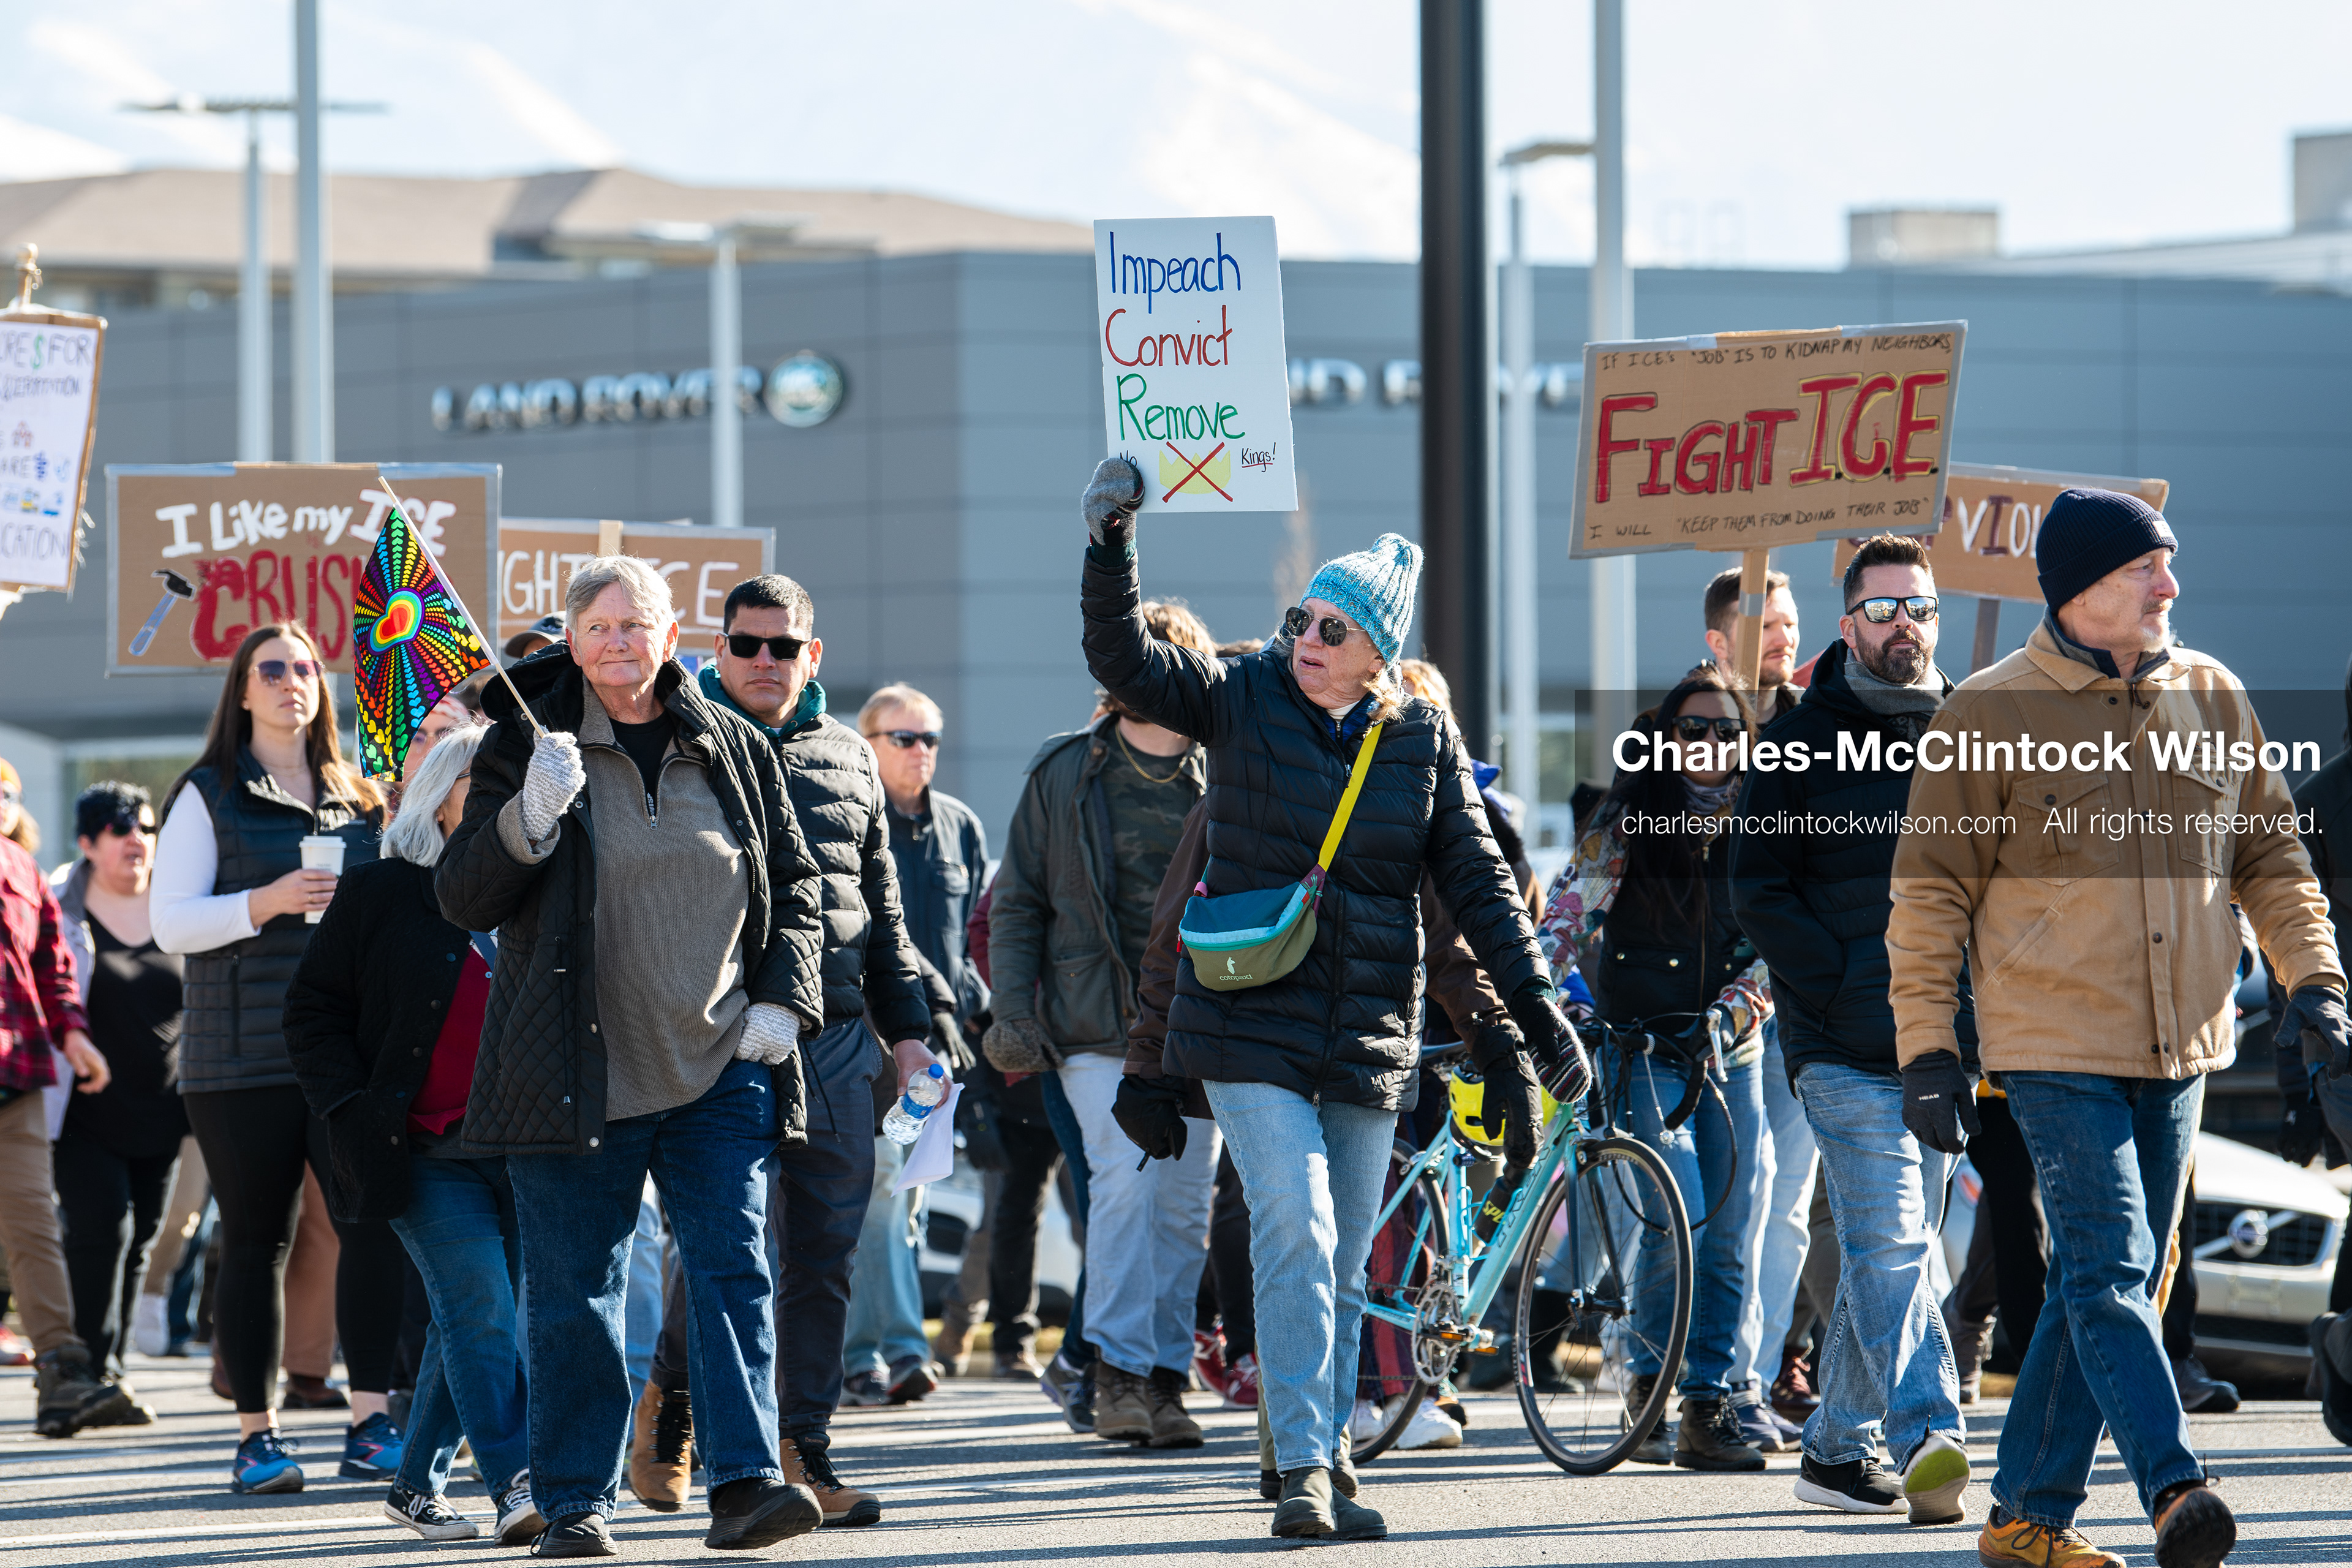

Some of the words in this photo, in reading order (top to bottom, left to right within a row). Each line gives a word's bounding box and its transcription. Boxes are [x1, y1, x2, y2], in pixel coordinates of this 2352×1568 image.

[1110, 231, 1242, 314] Impeach
[1105, 304, 1233, 367] Convict
[1601, 352, 1621, 371] IF
[1691, 347, 1730, 365] "JOB"
[1733, 347, 1755, 364] IS
[1761, 345, 1777, 360] TO
[1785, 337, 1841, 360] KIDNAP
[1841, 337, 1863, 355] MY
[1115, 372, 1246, 440] Remove
[1241, 442, 1276, 473] Kings!
[1595, 392, 1801, 505] FIGHT
[155, 502, 204, 559] I
[292, 505, 354, 547] my
[1589, 524, 1604, 540] I
[1615, 523, 1653, 537] WILL
[1722, 514, 1756, 532] THEM
[1759, 511, 1792, 528] FROM
[1794, 508, 1836, 526] DOING
[1845, 500, 1887, 518] THEIR
[189, 549, 368, 662] CRUS
[1918, 1093, 1940, 1101] HEAD
